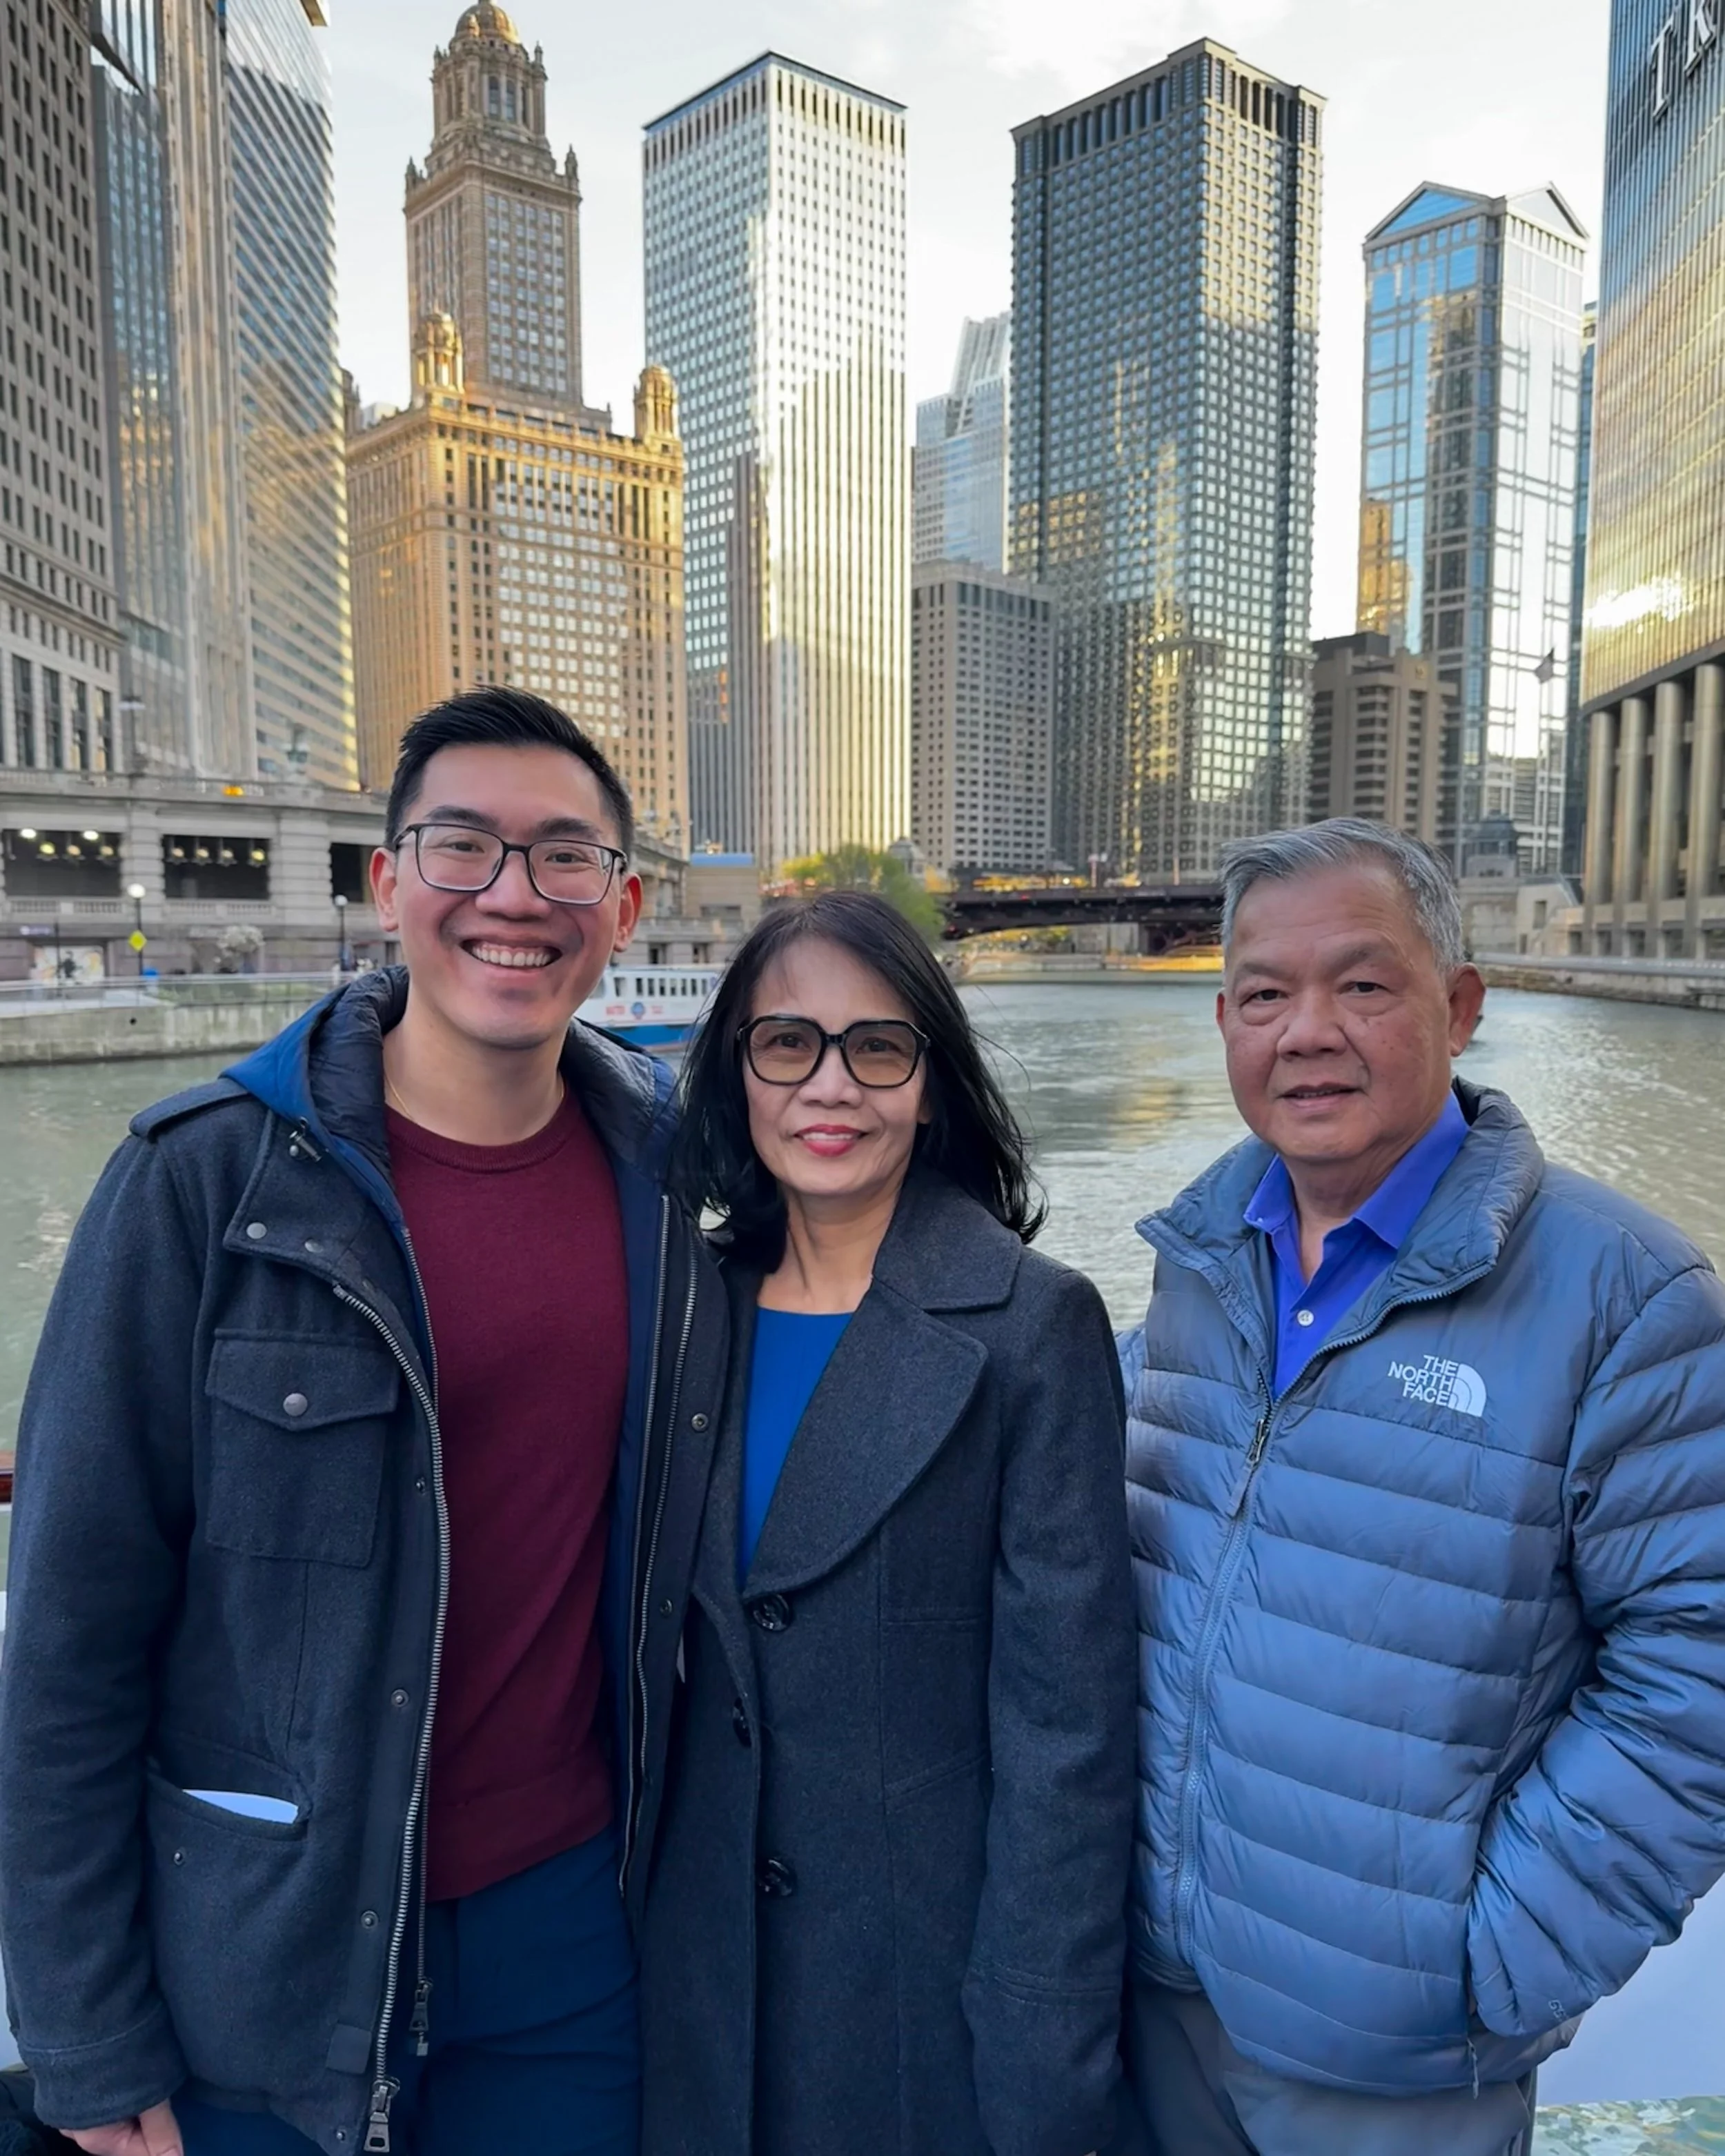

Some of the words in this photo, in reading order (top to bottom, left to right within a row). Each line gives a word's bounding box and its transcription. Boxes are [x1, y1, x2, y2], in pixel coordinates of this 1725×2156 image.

[1388, 1361, 1455, 1392] NORTH
[1423, 1354, 1459, 1376] THE
[1402, 1382, 1450, 1406] FACE
